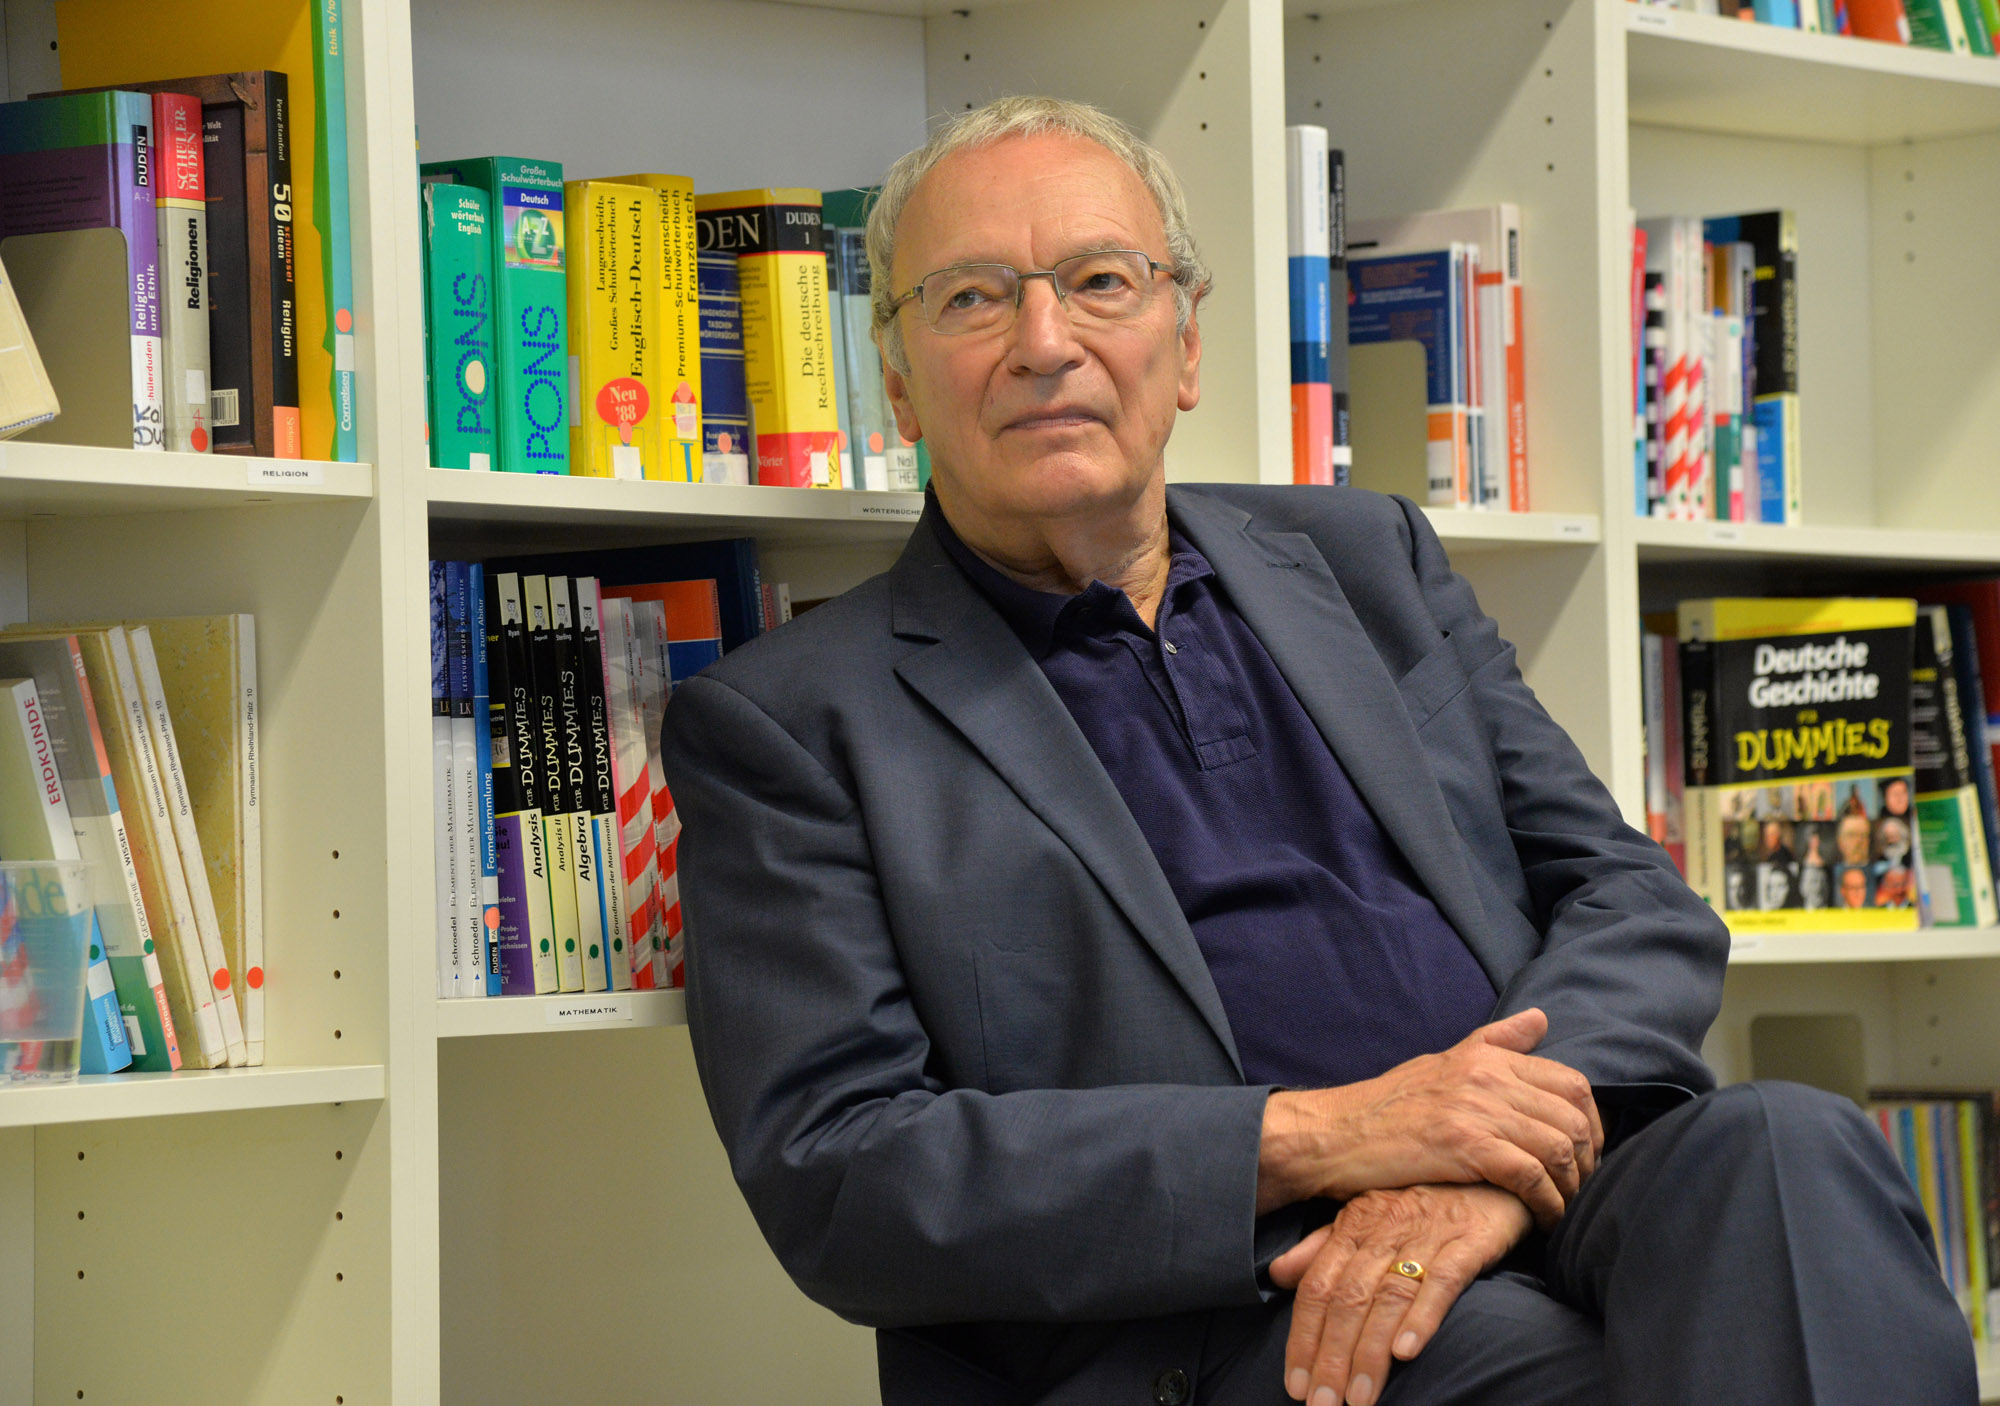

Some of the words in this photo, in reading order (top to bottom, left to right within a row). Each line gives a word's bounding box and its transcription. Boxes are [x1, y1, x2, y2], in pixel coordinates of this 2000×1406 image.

[329, 28, 338, 56] Ethik
[276, 98, 284, 118] Peter
[138, 135, 148, 186] DUDEN
[187, 132, 199, 190] DUDEN
[277, 124, 285, 161] Stanford
[501, 173, 563, 188] Schulwörterbuch
[520, 165, 547, 176] Großes
[274, 183, 292, 222] 50
[451, 210, 485, 224] wörterbuch
[520, 193, 549, 205] Deutsch
[785, 211, 821, 226] DUDEN
[277, 225, 285, 259] ideen
[458, 223, 482, 235] Englisch
[596, 195, 607, 291] Langenscheidts
[607, 196, 618, 304] Schulwörterbuch
[659, 188, 673, 290] Langenscheidt
[684, 191, 697, 303] Französisch
[147, 263, 156, 300] Ethik
[185, 218, 202, 310] Religionen
[629, 200, 647, 377] Englisch-Deutsch
[671, 189, 687, 377] Premium-Schulwörterbuch
[134, 273, 148, 330] Religion
[149, 305, 157, 331] und
[797, 264, 812, 342] deutsche
[281, 299, 292, 357] Religion
[453, 272, 491, 434] PONS
[609, 307, 619, 351] Großes
[812, 264, 828, 409] Rechtschreibung
[146, 340, 154, 401] hülerduden
[521, 305, 565, 460] PONS
[801, 346, 814, 377] Die
[341, 371, 352, 432] Cornelsen
[609, 386, 638, 404] Neu
[508, 629, 520, 638] Ryan
[1753, 636, 1869, 676] Deutsche
[460, 628, 468, 692] LEISTUNGSKURS
[155, 700, 162, 710] 10
[246, 688, 253, 698] 10
[460, 702, 472, 715] LK
[1748, 669, 1880, 708] Geschichte
[24, 697, 62, 806] ERDKUNDE
[159, 713, 177, 772] Rheinland-Pfalz
[246, 701, 254, 761] Rheinland-Pfalz
[514, 687, 534, 787] DUMMIES
[541, 695, 561, 792] DUMMIES
[561, 671, 585, 787] DUMMIES
[591, 695, 610, 792] DUMMIES
[1734, 717, 1892, 771] DUMMIES
[173, 770, 188, 816] Gymnasium
[248, 762, 256, 807] Gymnasium
[446, 768, 454, 833] MATHEMATIK
[466, 769, 475, 833] MATHEMATIK
[484, 772, 495, 870] Formelsammlung
[528, 813, 544, 879] Analysis
[604, 817, 614, 869] Mathematik
[554, 827, 566, 872] Analysis
[577, 816, 592, 882] Algebra
[117, 828, 132, 867] WISSEN
[130, 882, 149, 938] GEOGRAPHIE
[469, 859, 478, 908] ELEMENTE
[610, 886, 620, 936] Grundlagen
[450, 916, 459, 966] Schroedel
[470, 917, 481, 966] Schroedel
[156, 989, 173, 1039] Schroedel
[559, 1007, 618, 1016] MATHEMATIK
